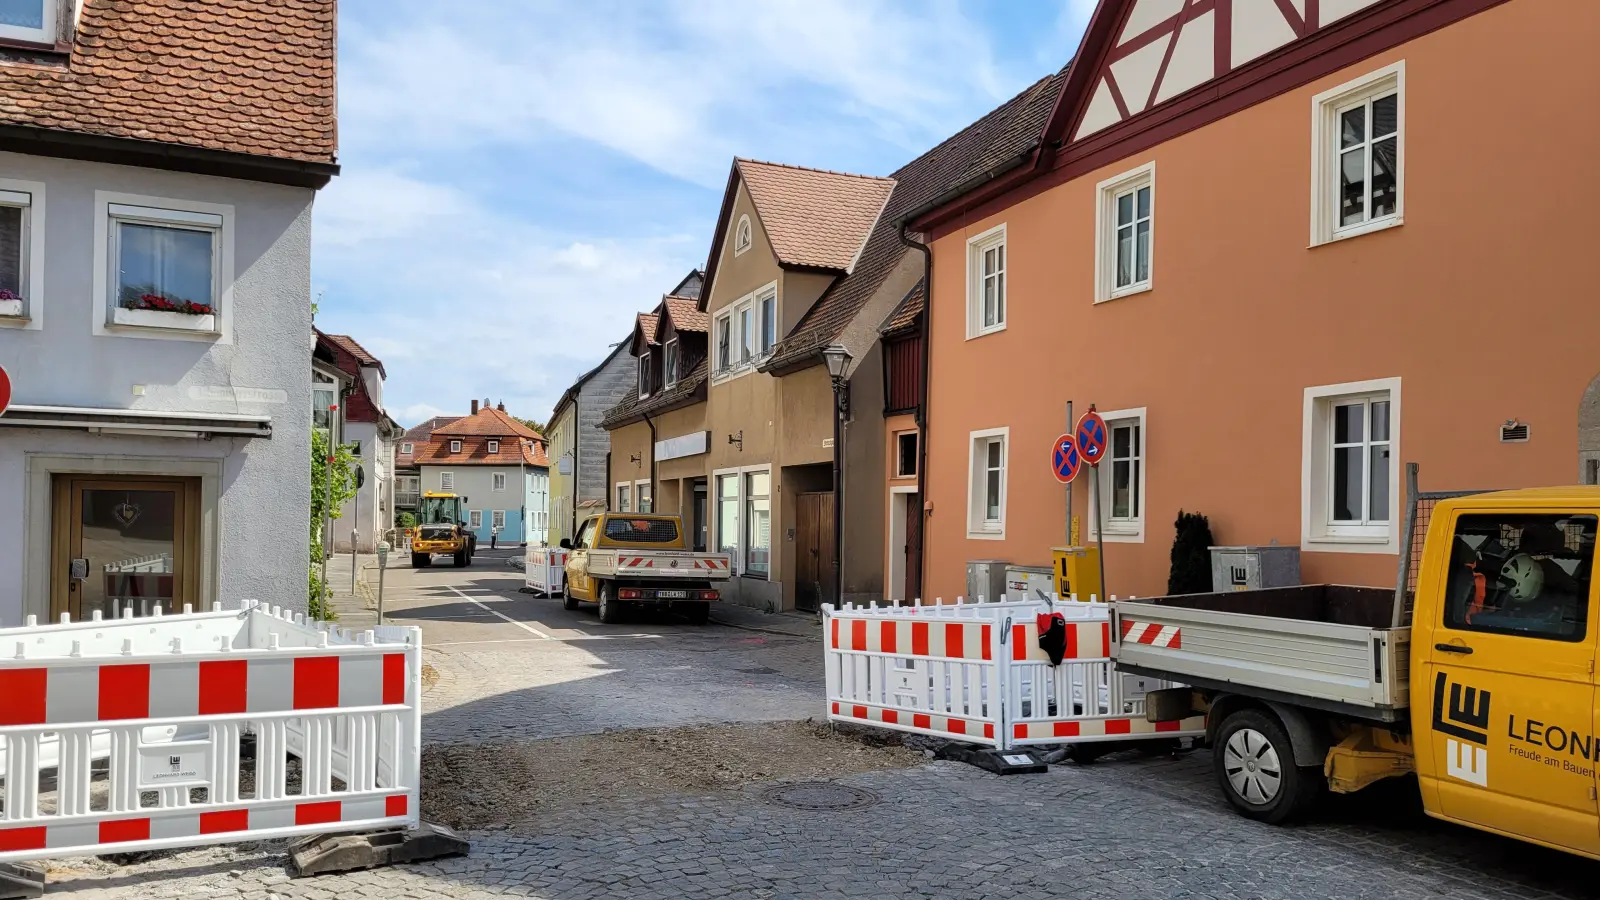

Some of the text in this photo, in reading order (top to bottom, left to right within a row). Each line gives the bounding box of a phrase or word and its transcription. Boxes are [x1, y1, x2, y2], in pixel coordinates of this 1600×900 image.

[1509, 743, 1541, 763] Freude
[1544, 755, 1560, 768] am
[1563, 760, 1596, 779] Bauen
